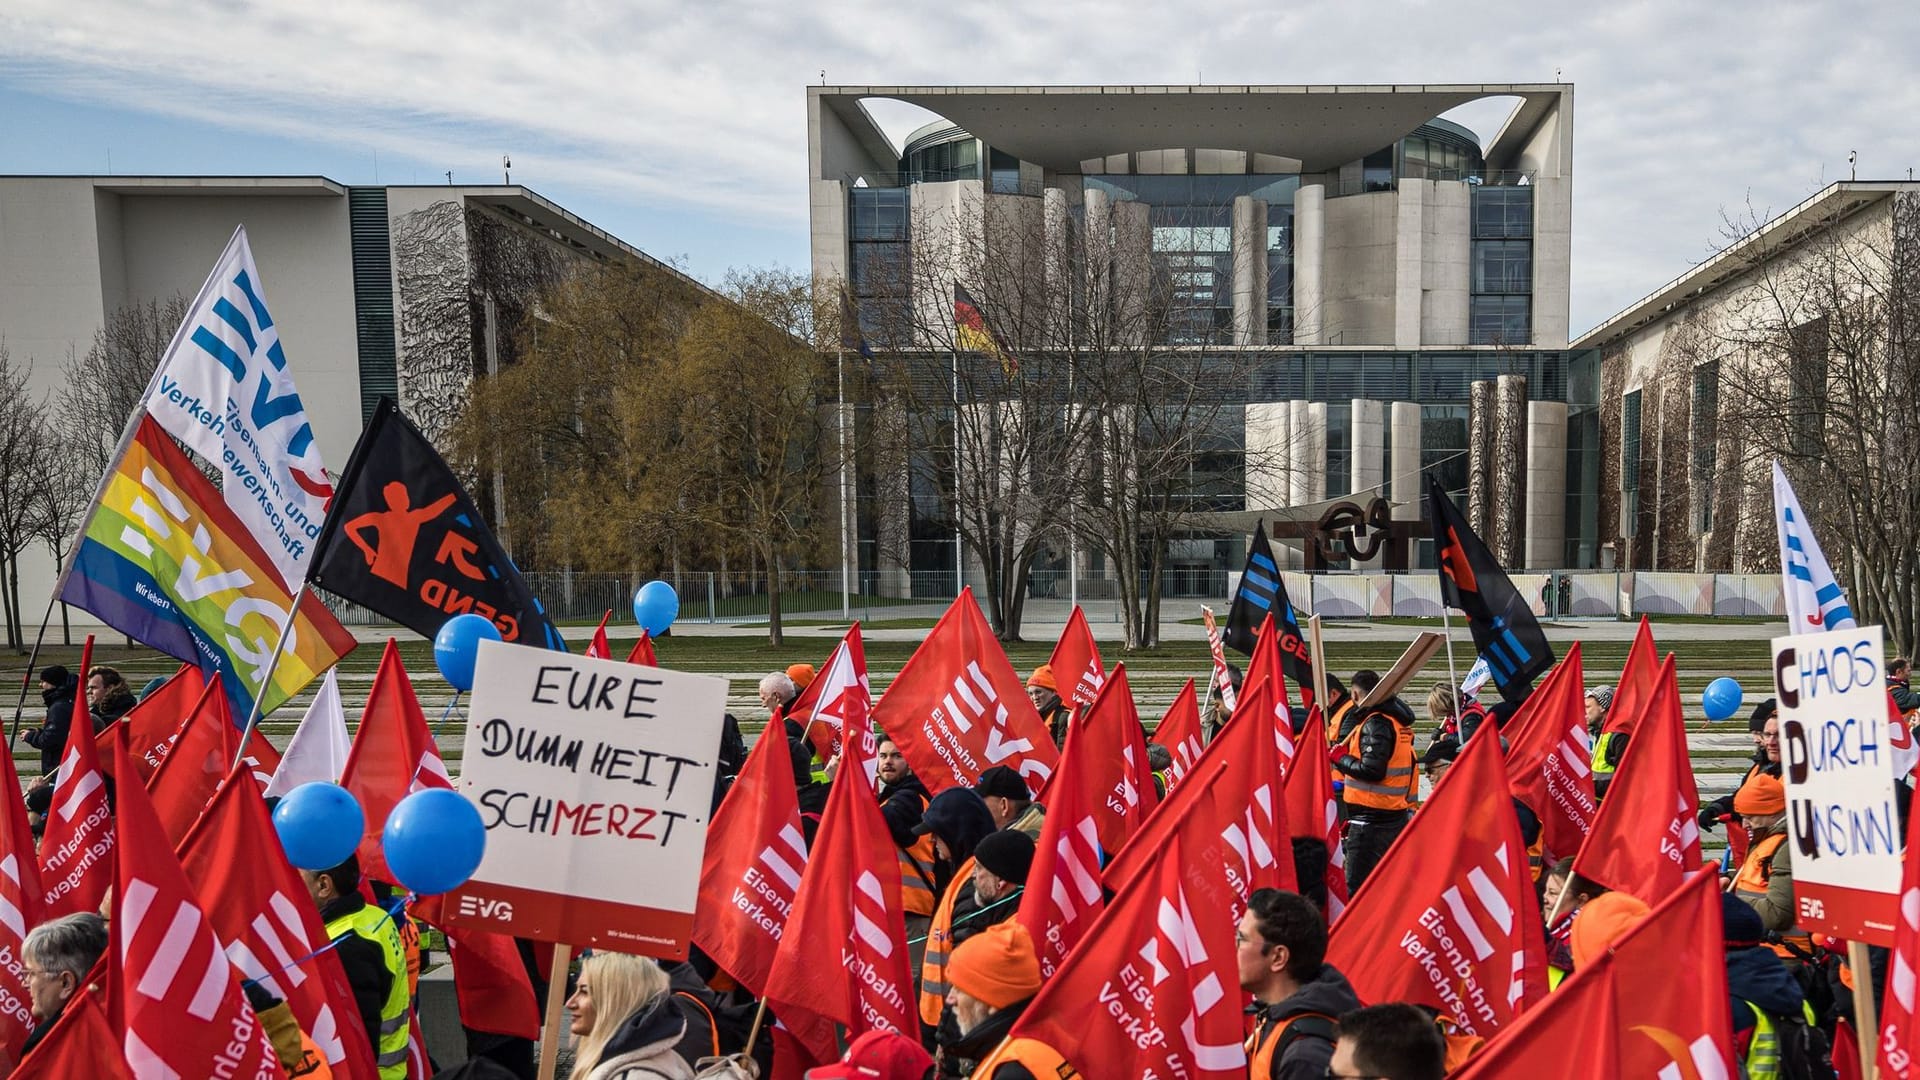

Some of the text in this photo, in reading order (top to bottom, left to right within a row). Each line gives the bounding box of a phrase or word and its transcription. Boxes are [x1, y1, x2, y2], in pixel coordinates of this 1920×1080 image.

[160, 375, 305, 560] Verkehewerkschaft
[285, 502, 323, 540] und
[120, 466, 297, 683] EVG
[531, 666, 663, 719] EURE
[1776, 640, 1877, 709] CHAOS
[482, 718, 702, 801] DUMMHEIT
[931, 706, 981, 773] Eisenbahn-
[1784, 719, 1878, 784] DURCH
[1547, 752, 1596, 815] Eisenbahn-
[480, 788, 688, 847] SCHMERZT
[1791, 798, 1894, 861] UNSINN
[460, 895, 513, 922] EVG
[1418, 906, 1499, 1027] Eisenbahn-
